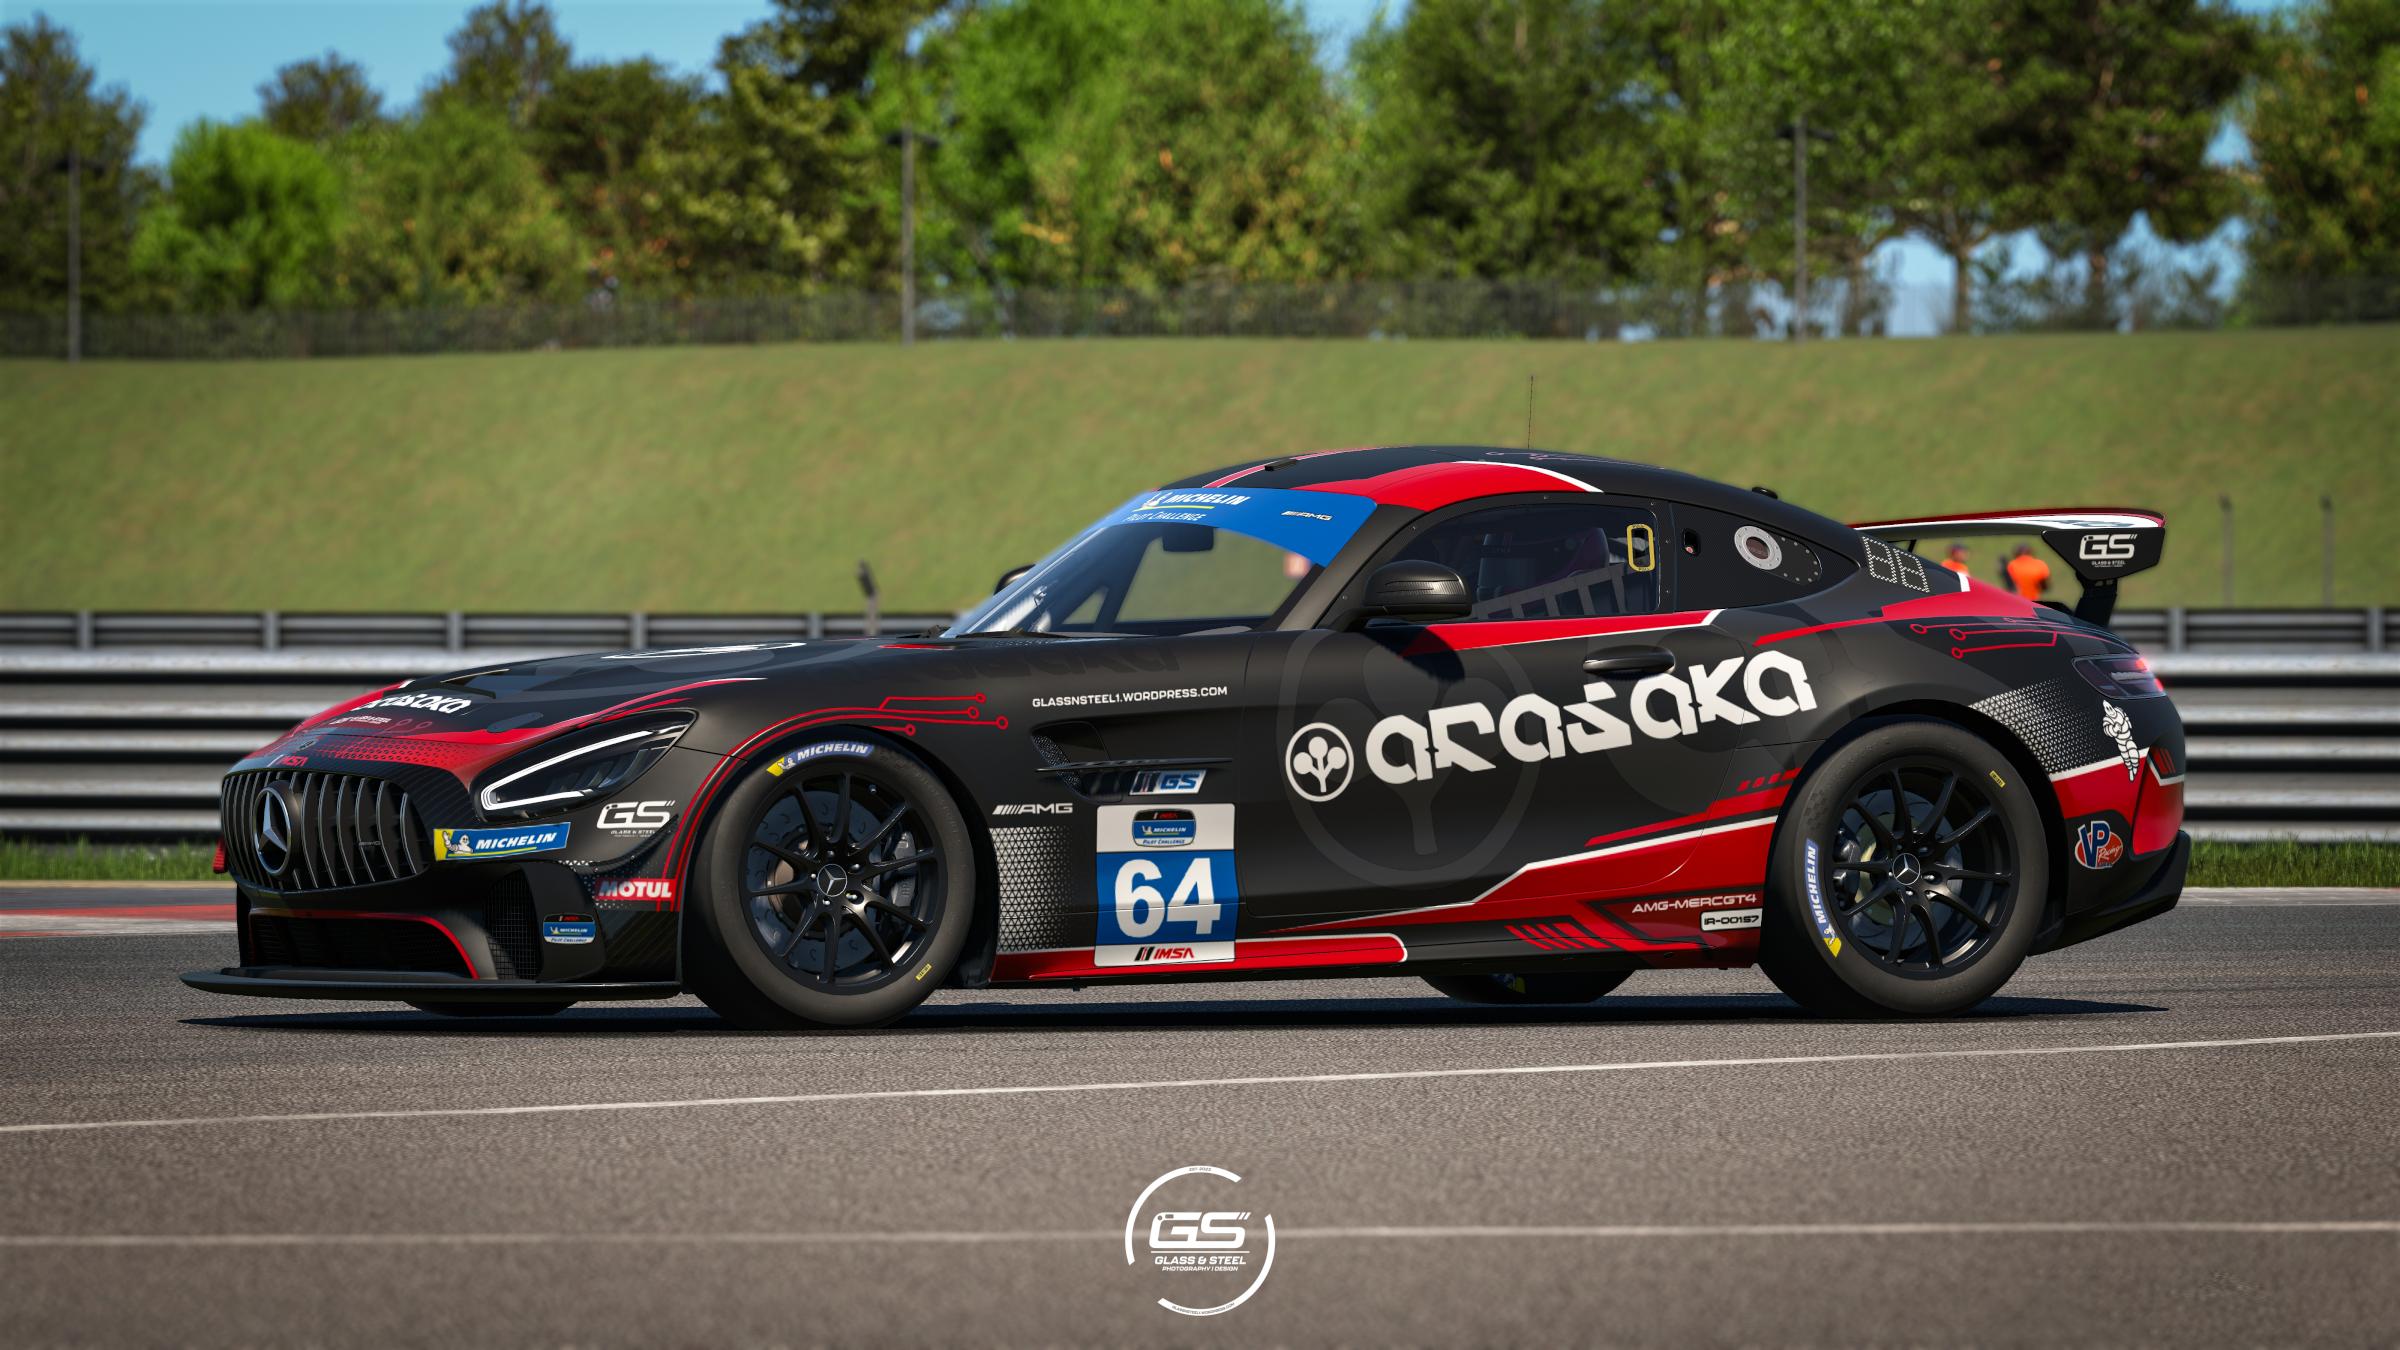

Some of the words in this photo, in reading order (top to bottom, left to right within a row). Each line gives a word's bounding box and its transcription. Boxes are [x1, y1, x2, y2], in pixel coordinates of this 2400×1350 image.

[1163, 493, 1251, 506] MICHELIN
[1032, 686, 1228, 708] GLASSNSTEEL1.WORDPRESS.COM
[797, 743, 868, 761] MICHELIN
[1160, 773, 1200, 790] GS
[1017, 803, 1073, 814] AMG
[475, 832, 557, 850] MICHELIN
[598, 881, 673, 898] MOTUL
[1806, 845, 1828, 924] MICHELIN
[1114, 857, 1221, 938] 64
[1631, 894, 1756, 913] AMG-MERCGT4
[1154, 947, 1194, 960] IMSA
